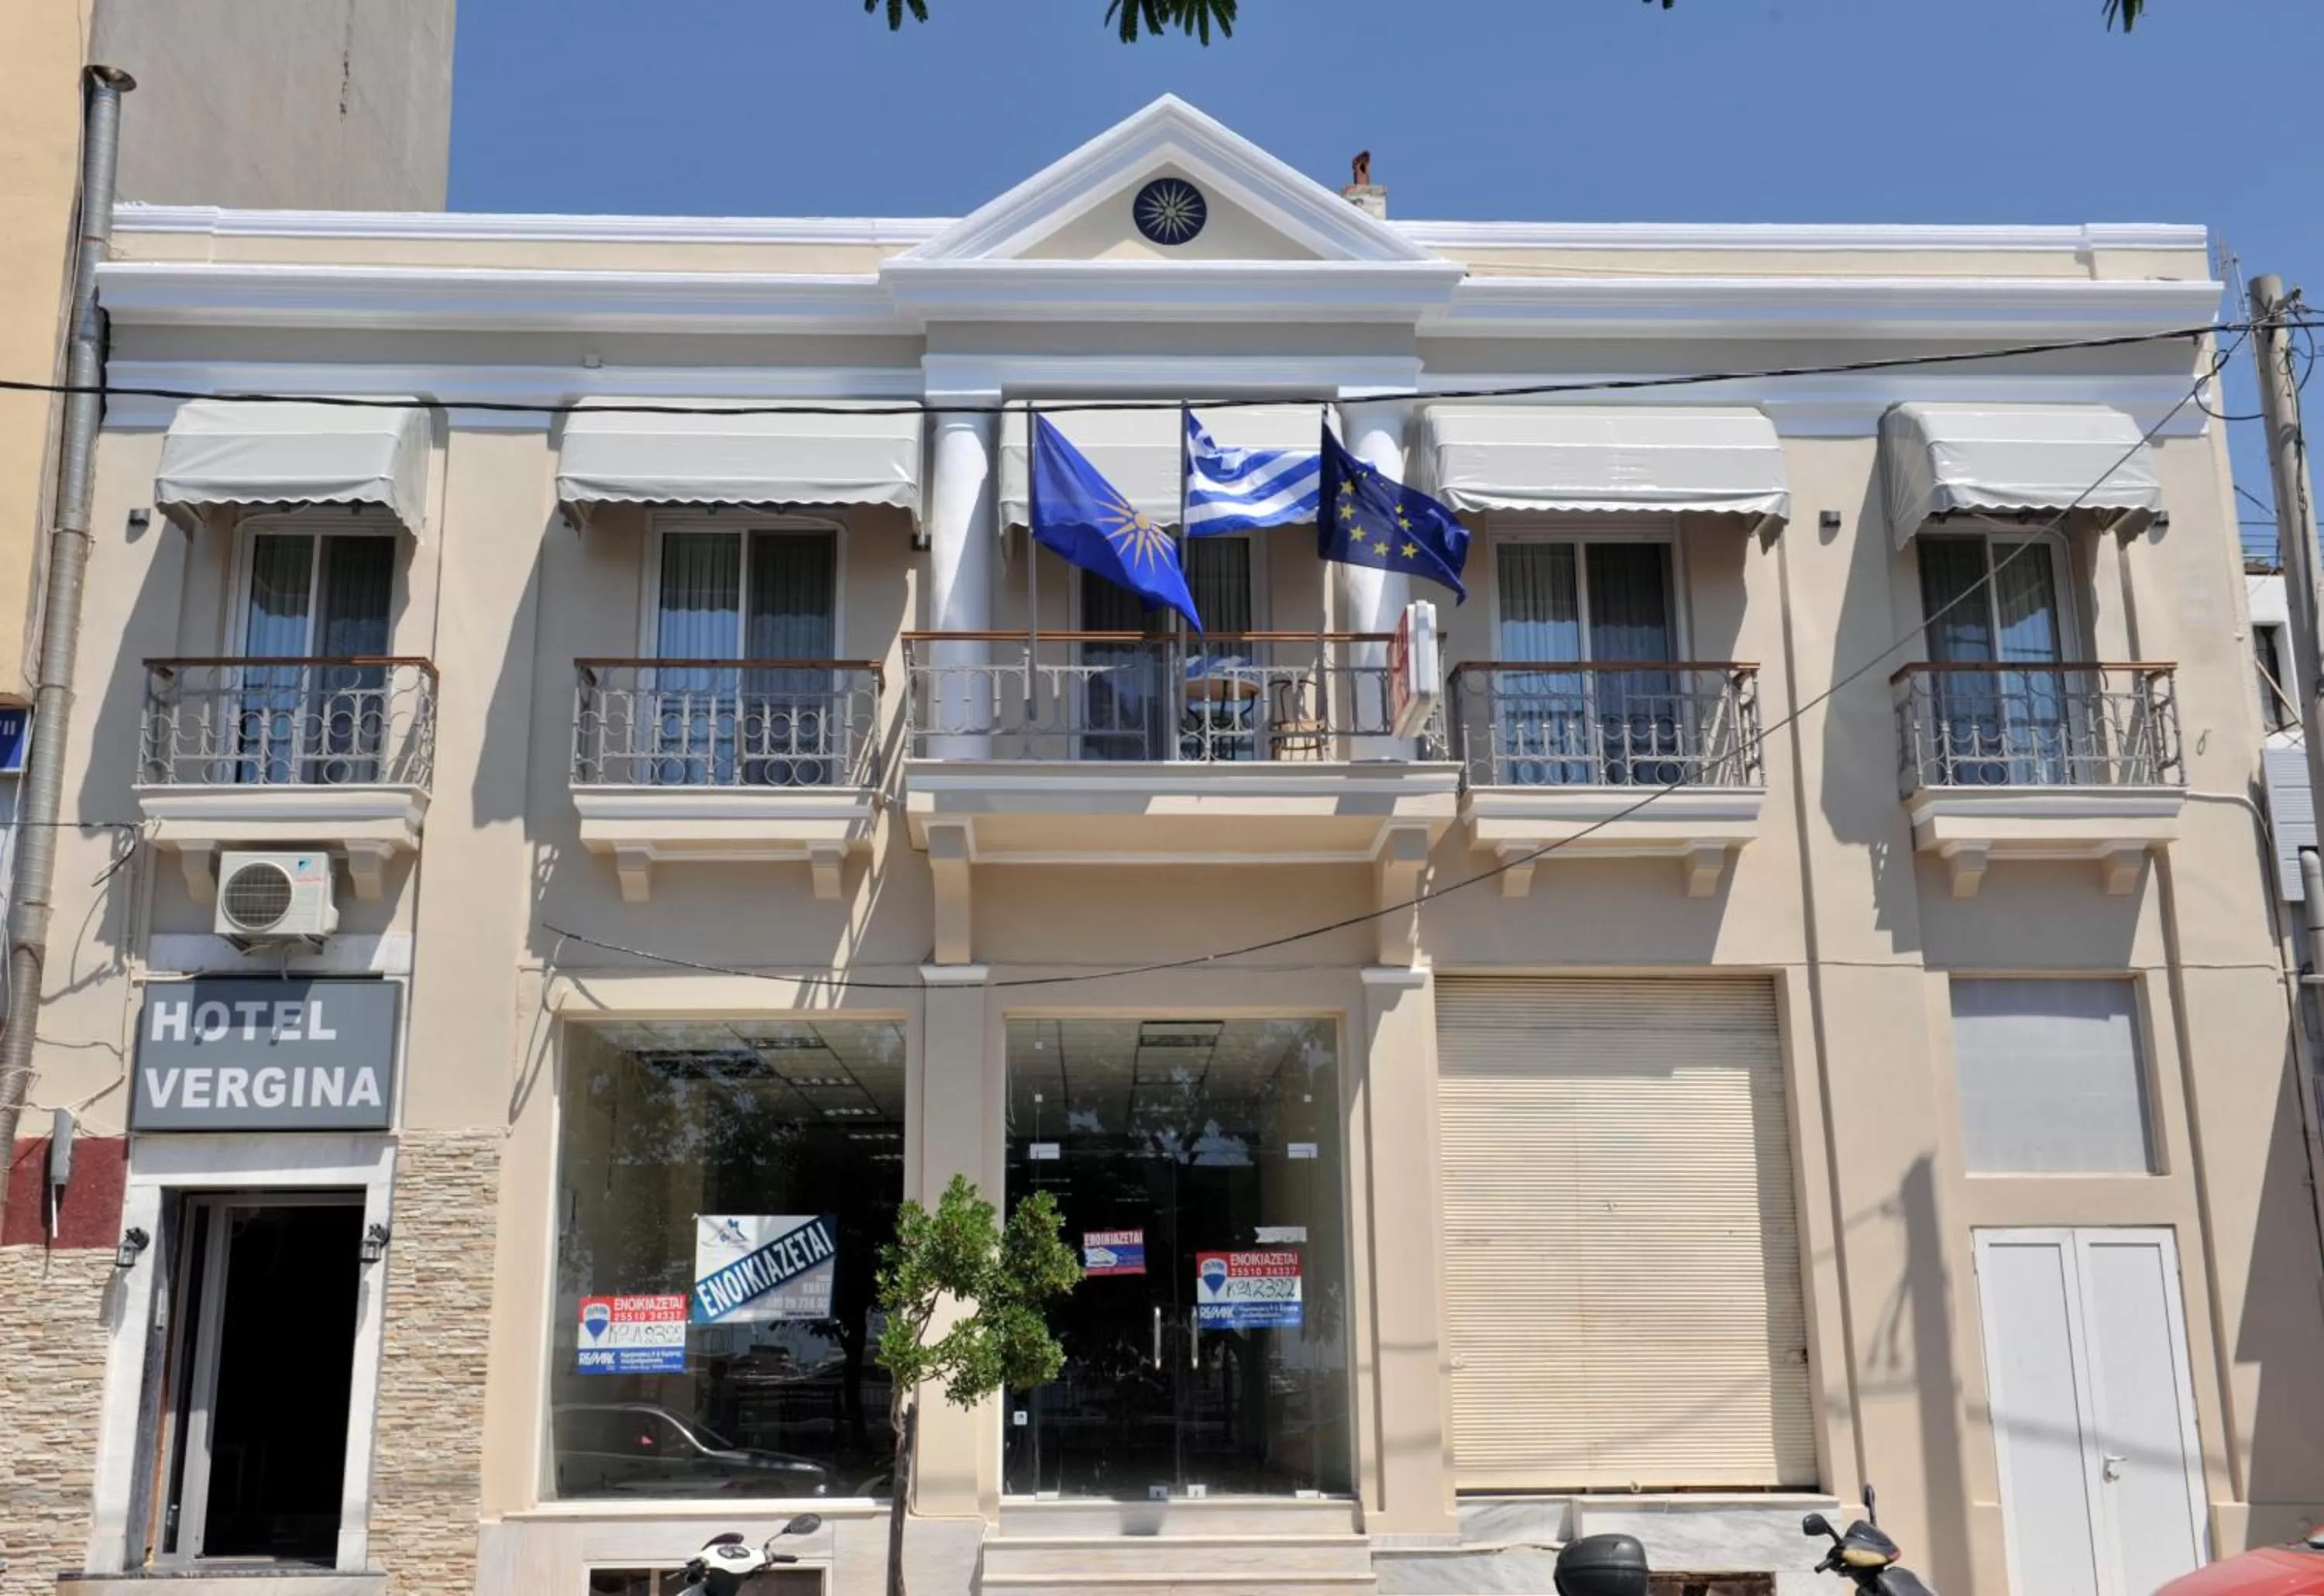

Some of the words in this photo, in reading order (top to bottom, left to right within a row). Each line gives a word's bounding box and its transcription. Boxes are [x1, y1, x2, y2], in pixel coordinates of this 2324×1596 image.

[151, 1000, 337, 1042] HOTEL
[144, 1066, 382, 1109] VERGINA
[696, 1220, 835, 1317] ΕΝΟΙΚΙΑΖΕΤΑΙ
[1229, 1252, 1298, 1266] ΕΝΟΙΚΙΑΖΕΤΑΙ
[614, 1296, 682, 1311] ΕΝΟΙΚΙΑΖΕΤΑΙ
